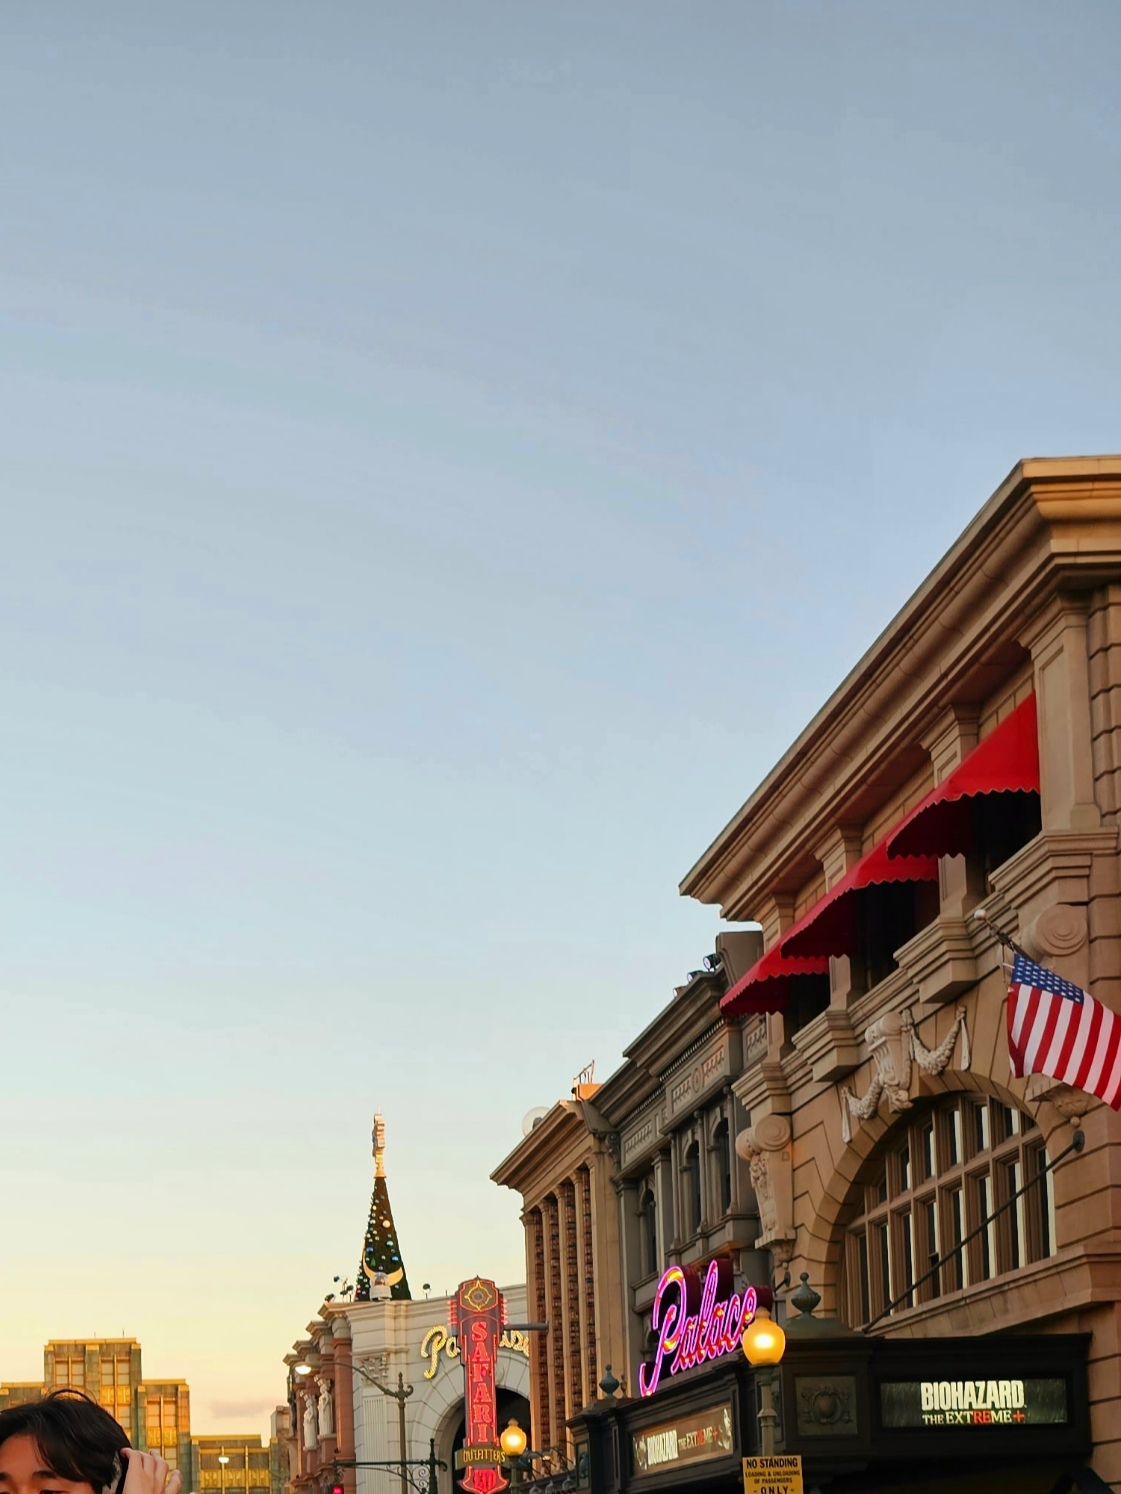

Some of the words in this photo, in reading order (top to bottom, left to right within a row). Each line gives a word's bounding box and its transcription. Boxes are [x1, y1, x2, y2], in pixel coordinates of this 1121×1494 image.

[639, 1259, 758, 1398] Palace
[471, 1321, 492, 1443] SAFARI
[920, 1379, 1025, 1411] BIOHAZARD
[922, 1414, 945, 1425] THE
[463, 1449, 506, 1463] OUTFITTERS
[746, 1458, 757, 1468] NO
[759, 1457, 798, 1468] STANDING
